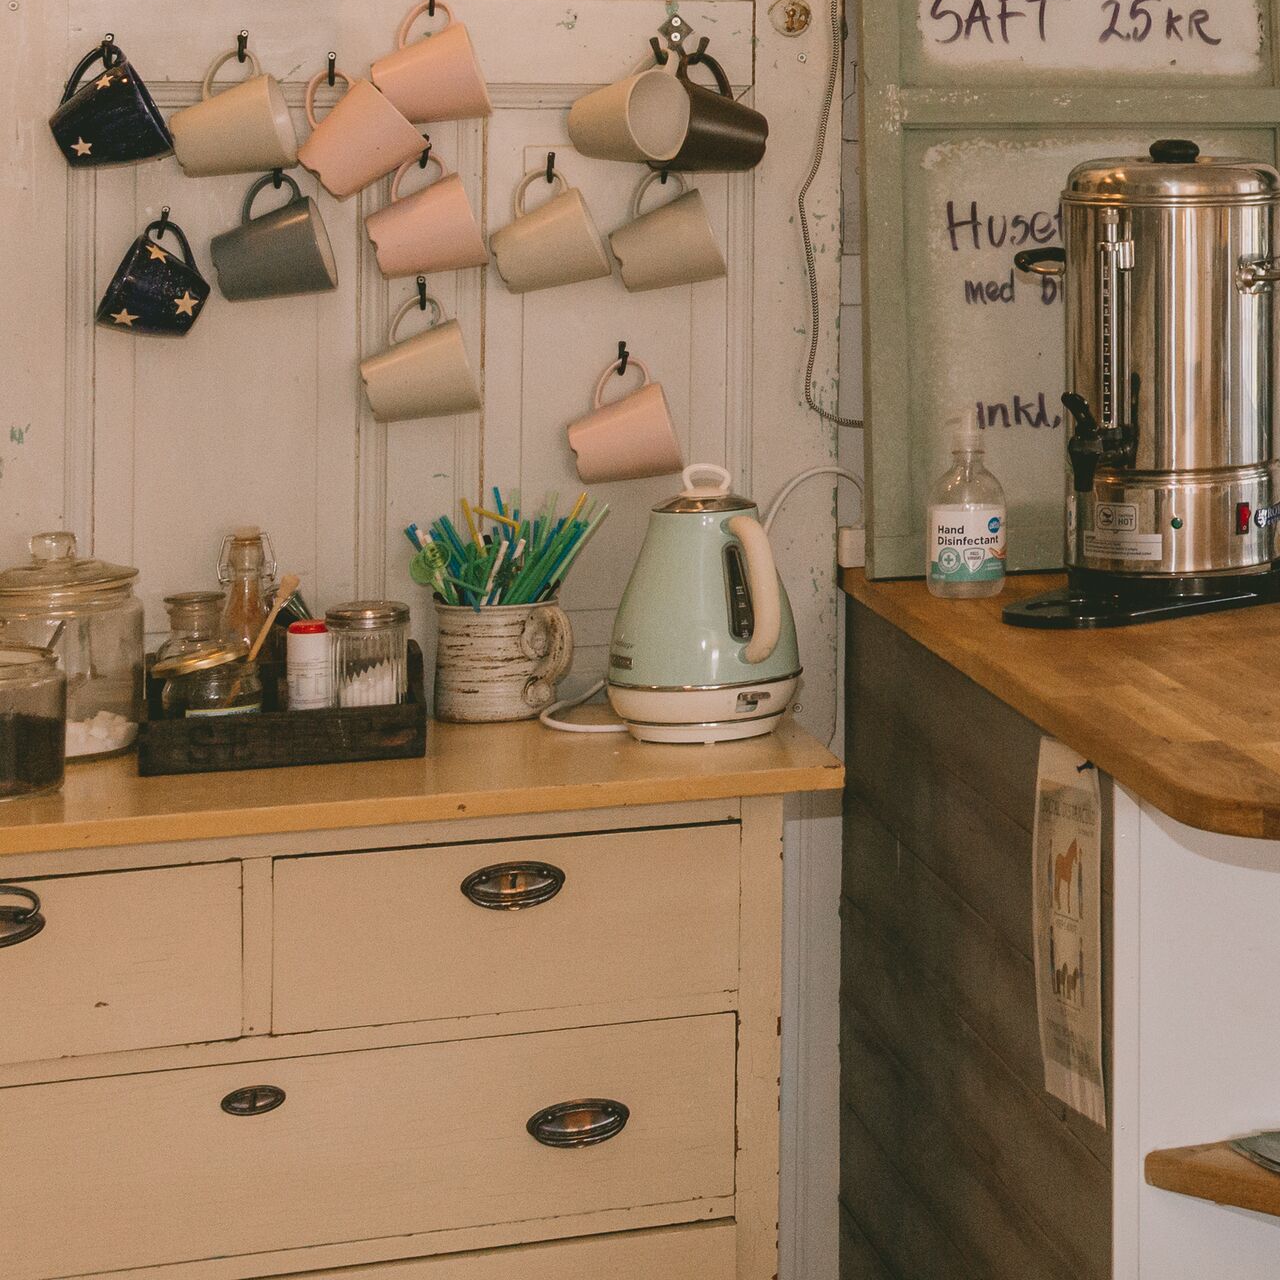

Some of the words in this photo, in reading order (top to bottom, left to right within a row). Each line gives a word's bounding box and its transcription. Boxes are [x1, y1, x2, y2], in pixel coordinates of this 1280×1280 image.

[964, 268, 1015, 306] med
[937, 525, 965, 535] Hand
[937, 535, 999, 546] Disinfectant
